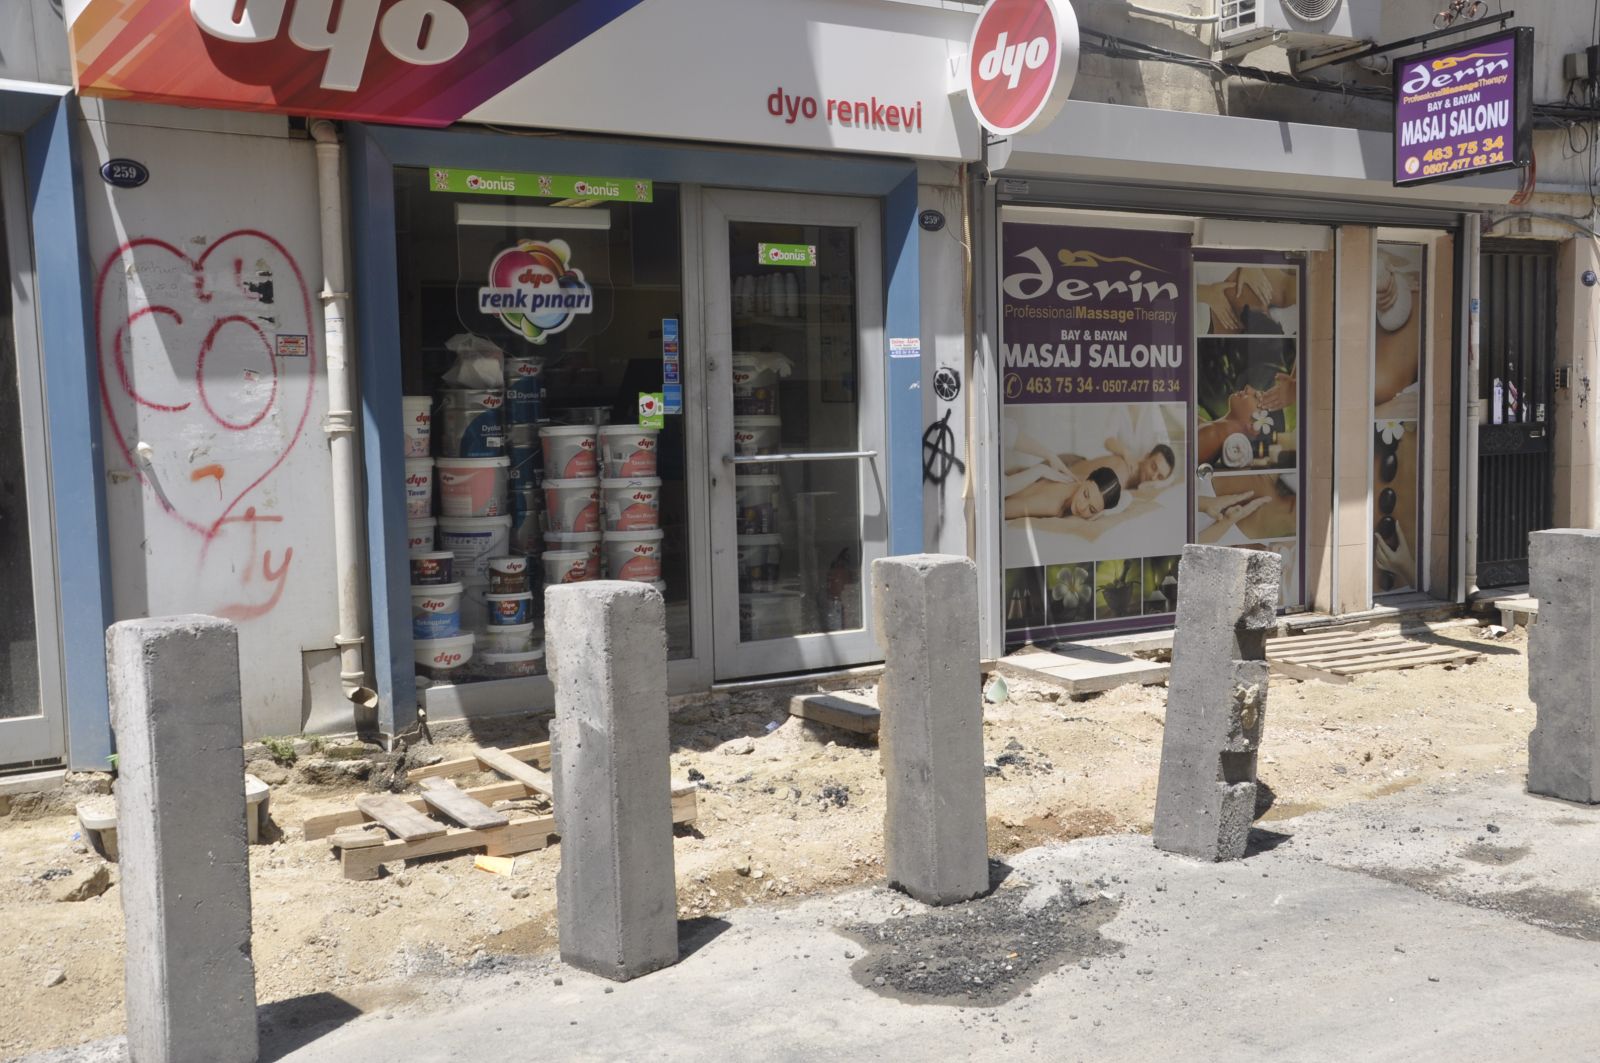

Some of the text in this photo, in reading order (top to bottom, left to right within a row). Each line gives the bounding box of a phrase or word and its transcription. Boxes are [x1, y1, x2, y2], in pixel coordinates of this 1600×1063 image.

[978, 31, 1050, 90] dyo
[1402, 58, 1509, 94] derin
[1427, 92, 1480, 112] BAY & BAYAN
[767, 87, 922, 133] dyo renkevi
[1401, 99, 1509, 147] MASAJ SALONU
[1423, 136, 1504, 163] 463 75 34
[1472, 154, 1487, 167] 62
[1489, 151, 1504, 164] 34
[112, 165, 137, 179] 259
[518, 269, 554, 288] dyo
[1003, 246, 1179, 303] derin
[481, 289, 528, 308] renk
[1061, 329, 1127, 341] BAY & BAYAN
[1003, 343, 1183, 368] MASAJ SALONU
[734, 373, 750, 383] yo
[1026, 377, 1051, 393] 463
[1056, 377, 1072, 393] 75
[1077, 377, 1094, 393] 34
[1102, 380, 1150, 393] 0507.477
[1152, 380, 1166, 392] 62
[1167, 380, 1181, 392] 34
[483, 396, 501, 407] dyo
[638, 438, 655, 448] dyo
[406, 474, 428, 487] dyo
[633, 491, 653, 501] dyo
[408, 537, 422, 548] yo
[634, 544, 654, 554] dyo
[507, 562, 523, 571] dyo
[422, 600, 445, 610] dyo
[434, 652, 461, 665] dyo
